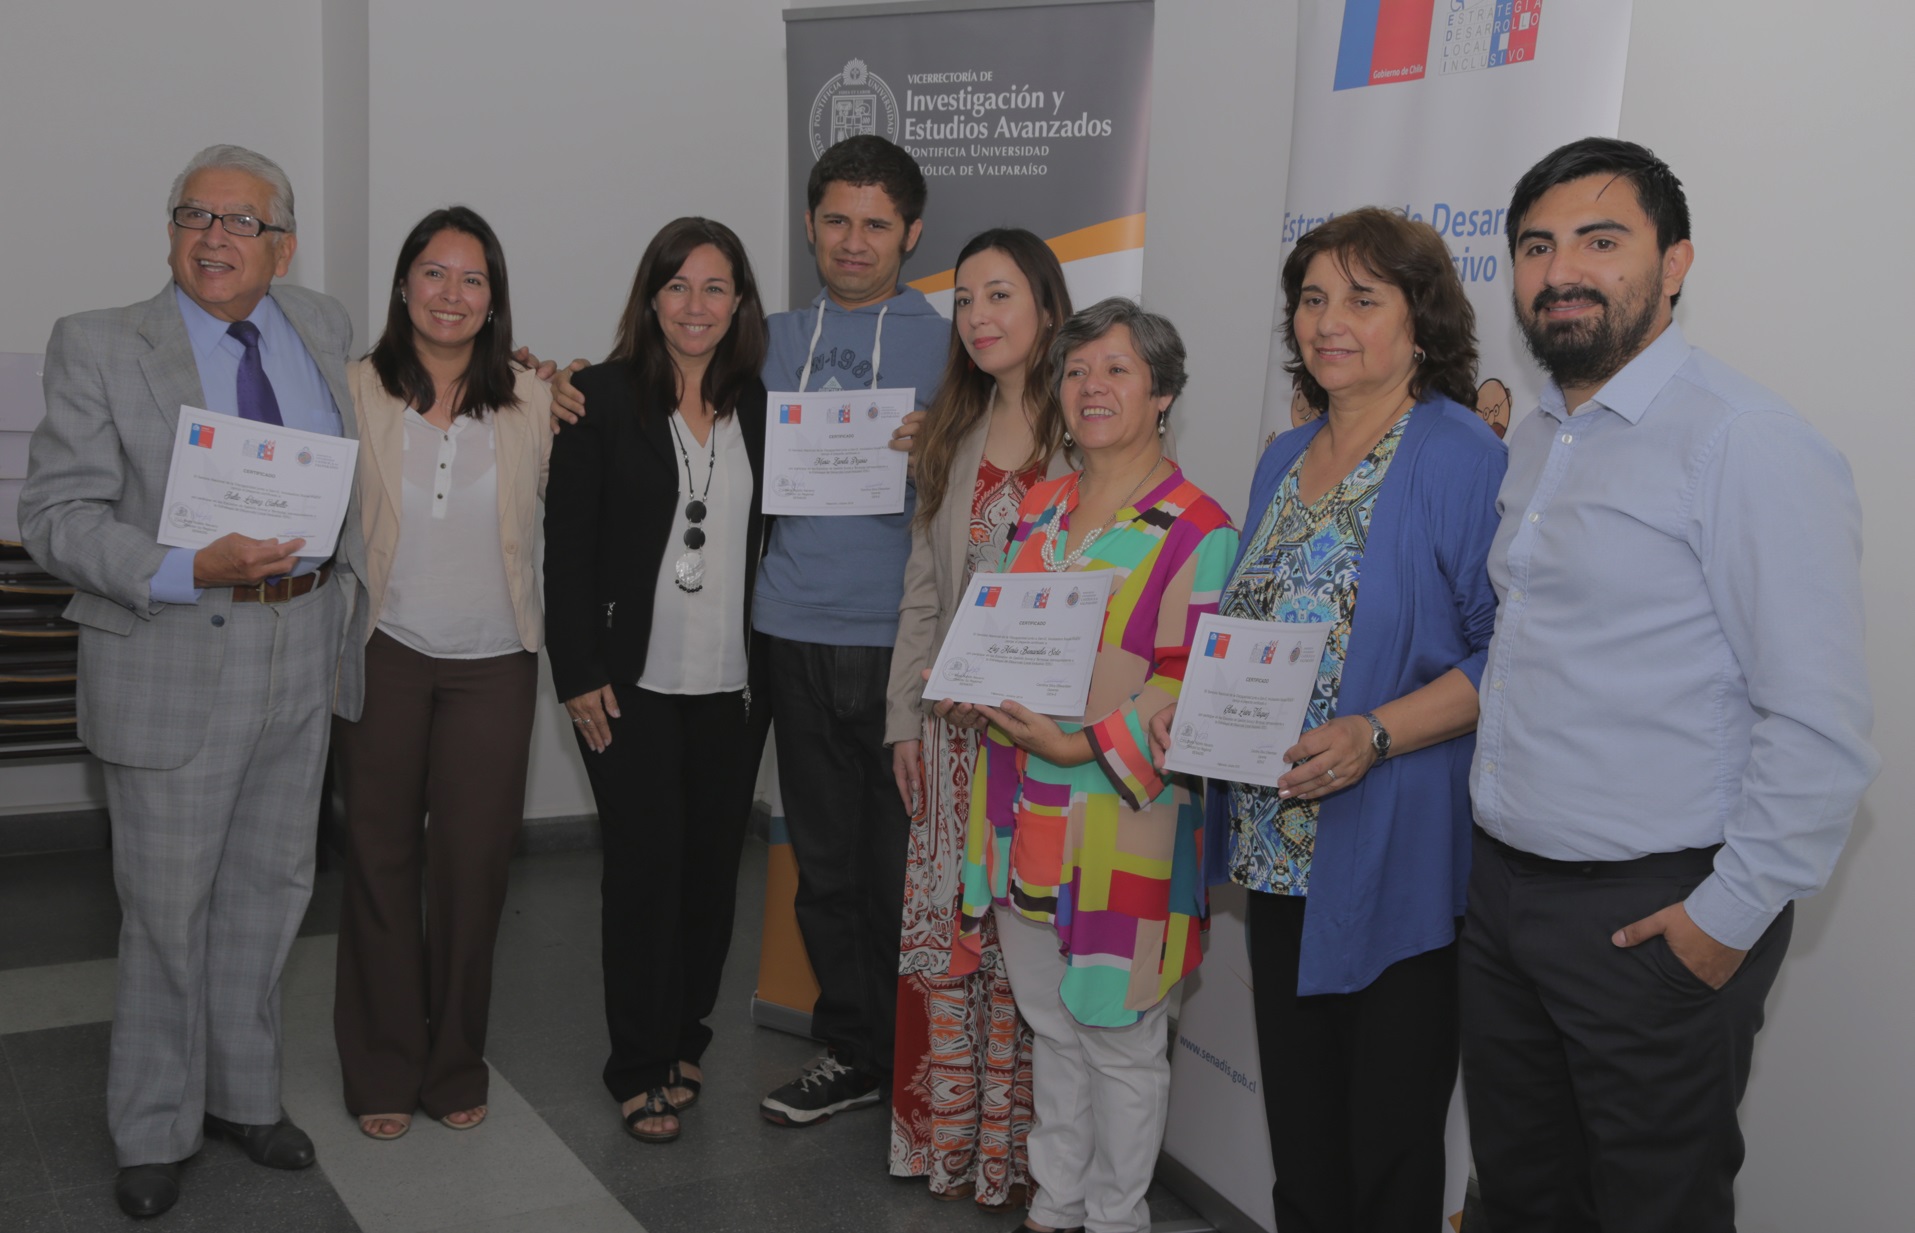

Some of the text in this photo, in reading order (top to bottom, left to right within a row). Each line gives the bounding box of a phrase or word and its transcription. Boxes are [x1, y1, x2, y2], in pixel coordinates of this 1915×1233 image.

[1446, 13, 1539, 41] DESARROLLO
[1444, 40, 1488, 57] LOCAL
[1443, 48, 1524, 72] INCLUSIVO
[908, 69, 993, 84] VICERRECTORÍA DE
[1373, 64, 1423, 79] Gobierno de Chile
[906, 84, 1065, 117] Investigación y
[905, 112, 1112, 140] Estudios Avanzados
[971, 144, 1049, 157] UNIVERSIDAD
[919, 163, 956, 176] TÓLICA
[960, 165, 974, 176] DE
[243, 468, 276, 479] CERTIFICADO
[1245, 676, 1270, 684] CERTIFICADO
[1180, 1035, 1257, 1094] www.senadis.gob.cl
